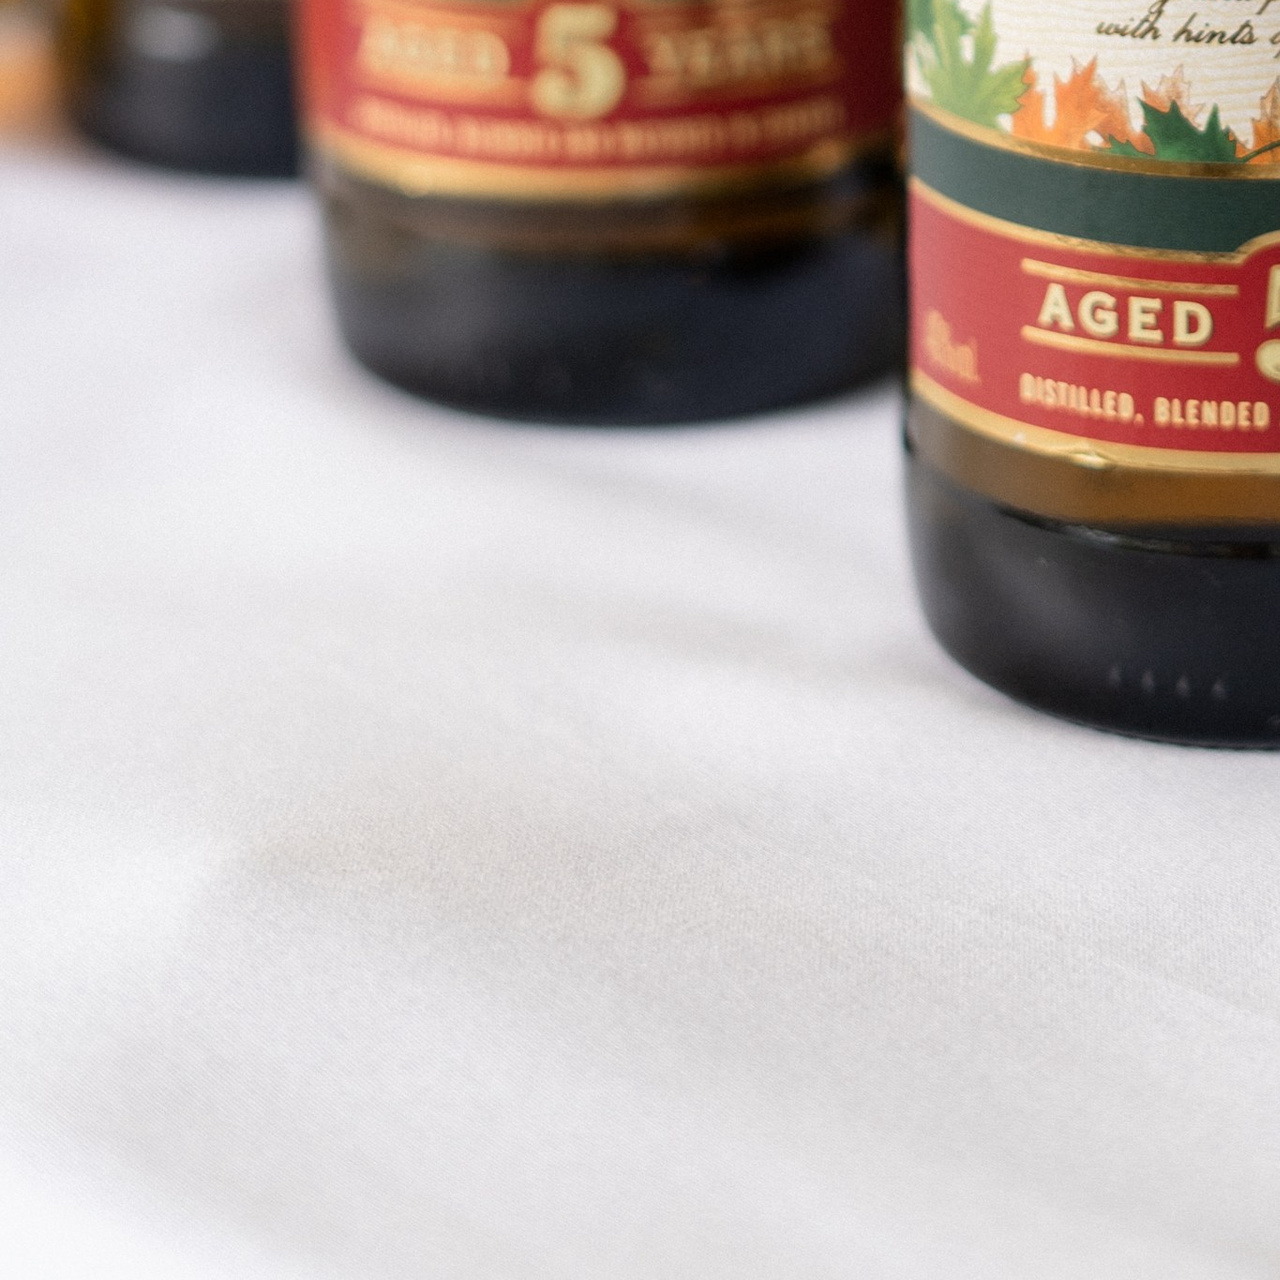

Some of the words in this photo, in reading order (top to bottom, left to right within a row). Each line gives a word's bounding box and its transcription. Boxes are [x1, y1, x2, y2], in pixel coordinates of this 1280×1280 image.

[1096, 8, 1162, 41] with
[1172, 12, 1259, 45] hints
[531, 3, 627, 121] 5
[1038, 281, 1213, 347] AGED
[1019, 372, 1144, 428] DISTILLED,
[1154, 397, 1271, 431] BLENDED
